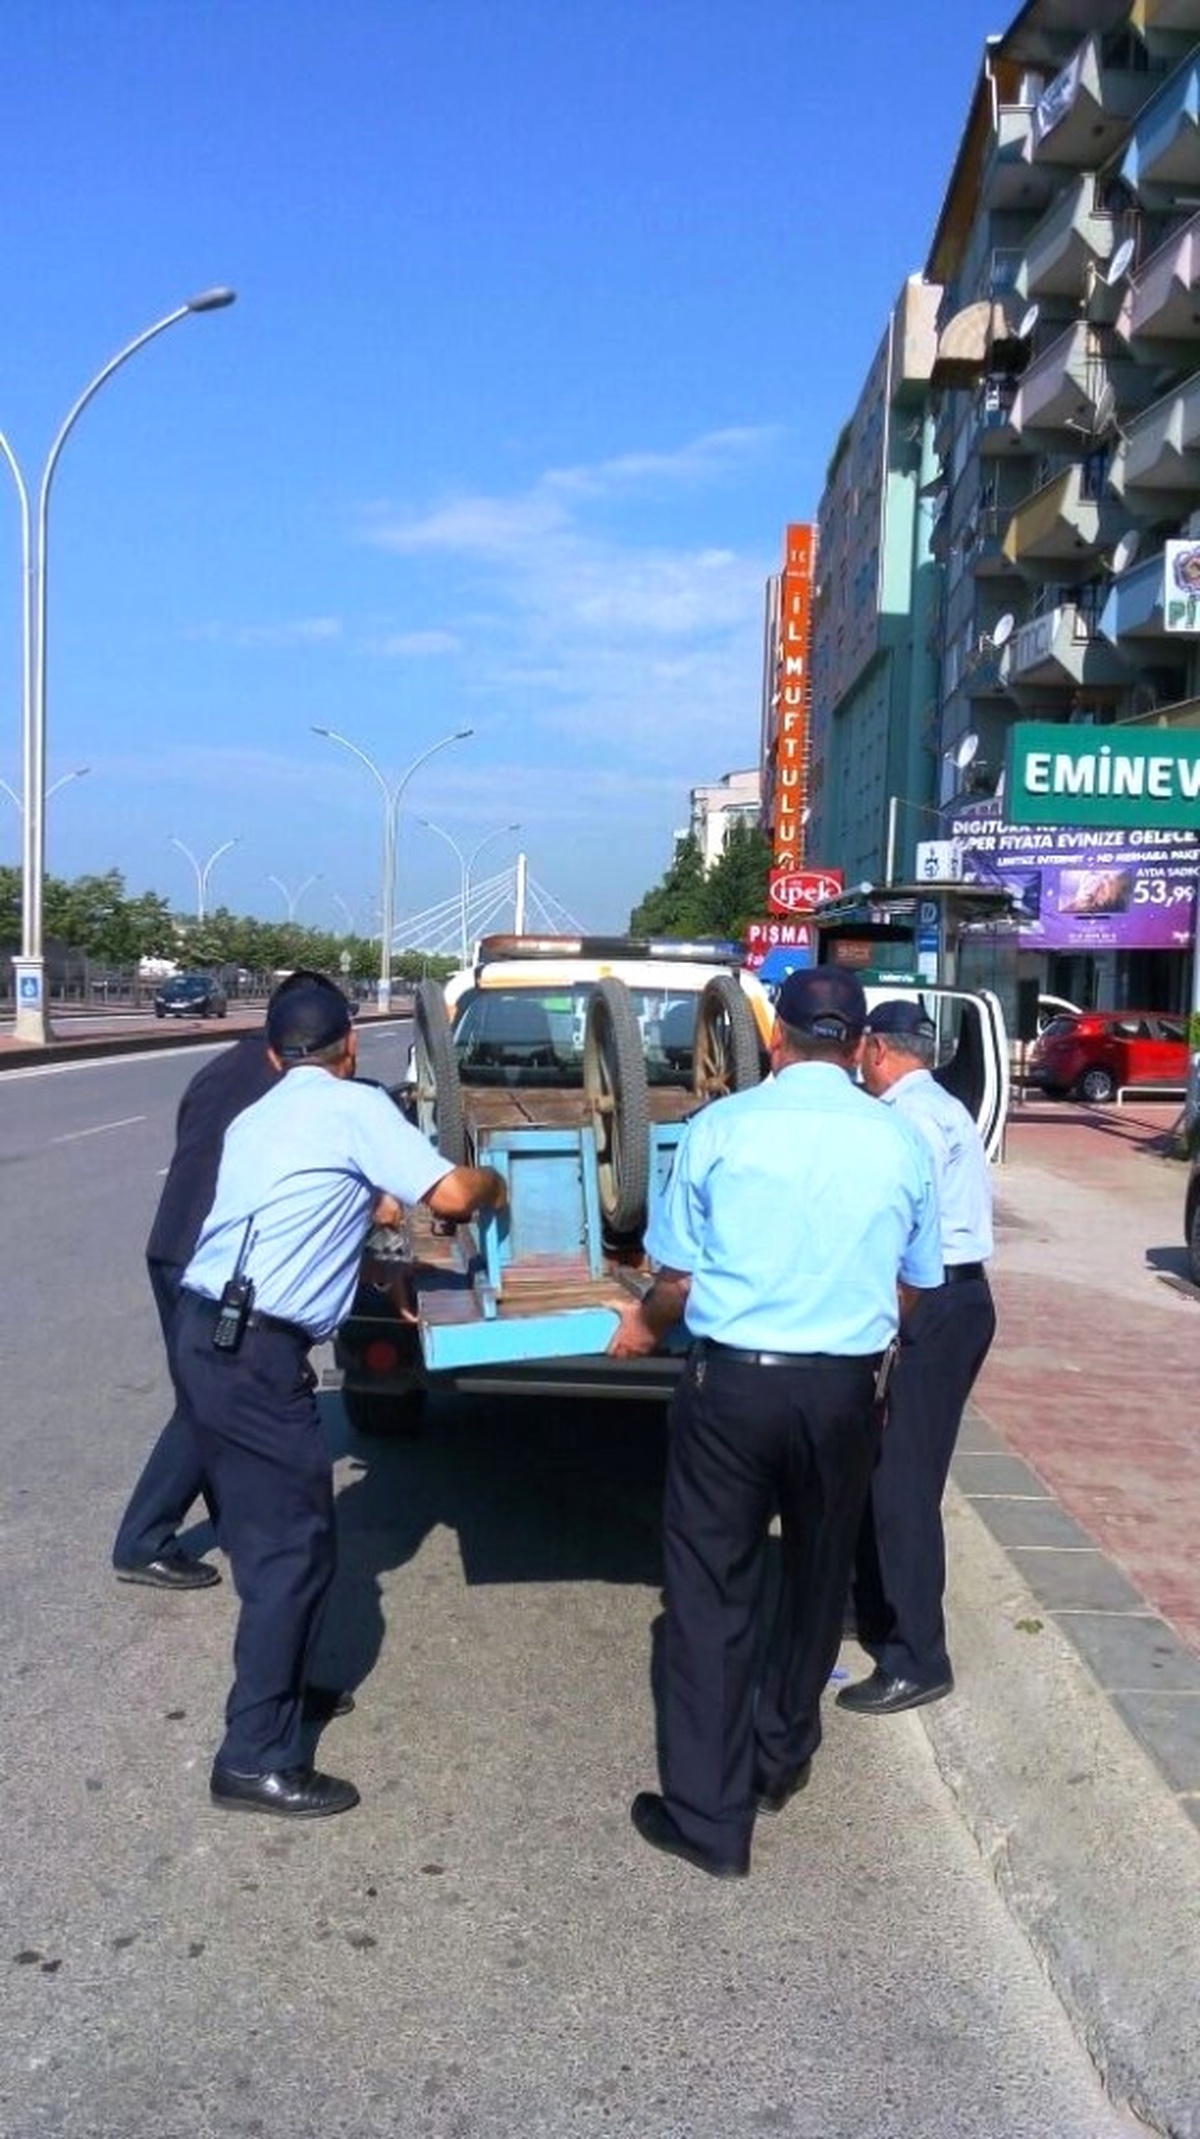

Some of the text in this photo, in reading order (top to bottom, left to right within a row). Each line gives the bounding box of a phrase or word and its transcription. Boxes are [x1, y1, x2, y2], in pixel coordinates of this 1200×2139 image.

[1129, 829, 1199, 846] GELECE
[1136, 867, 1166, 878] AYDA
[1133, 879, 1196, 908] 53,99
